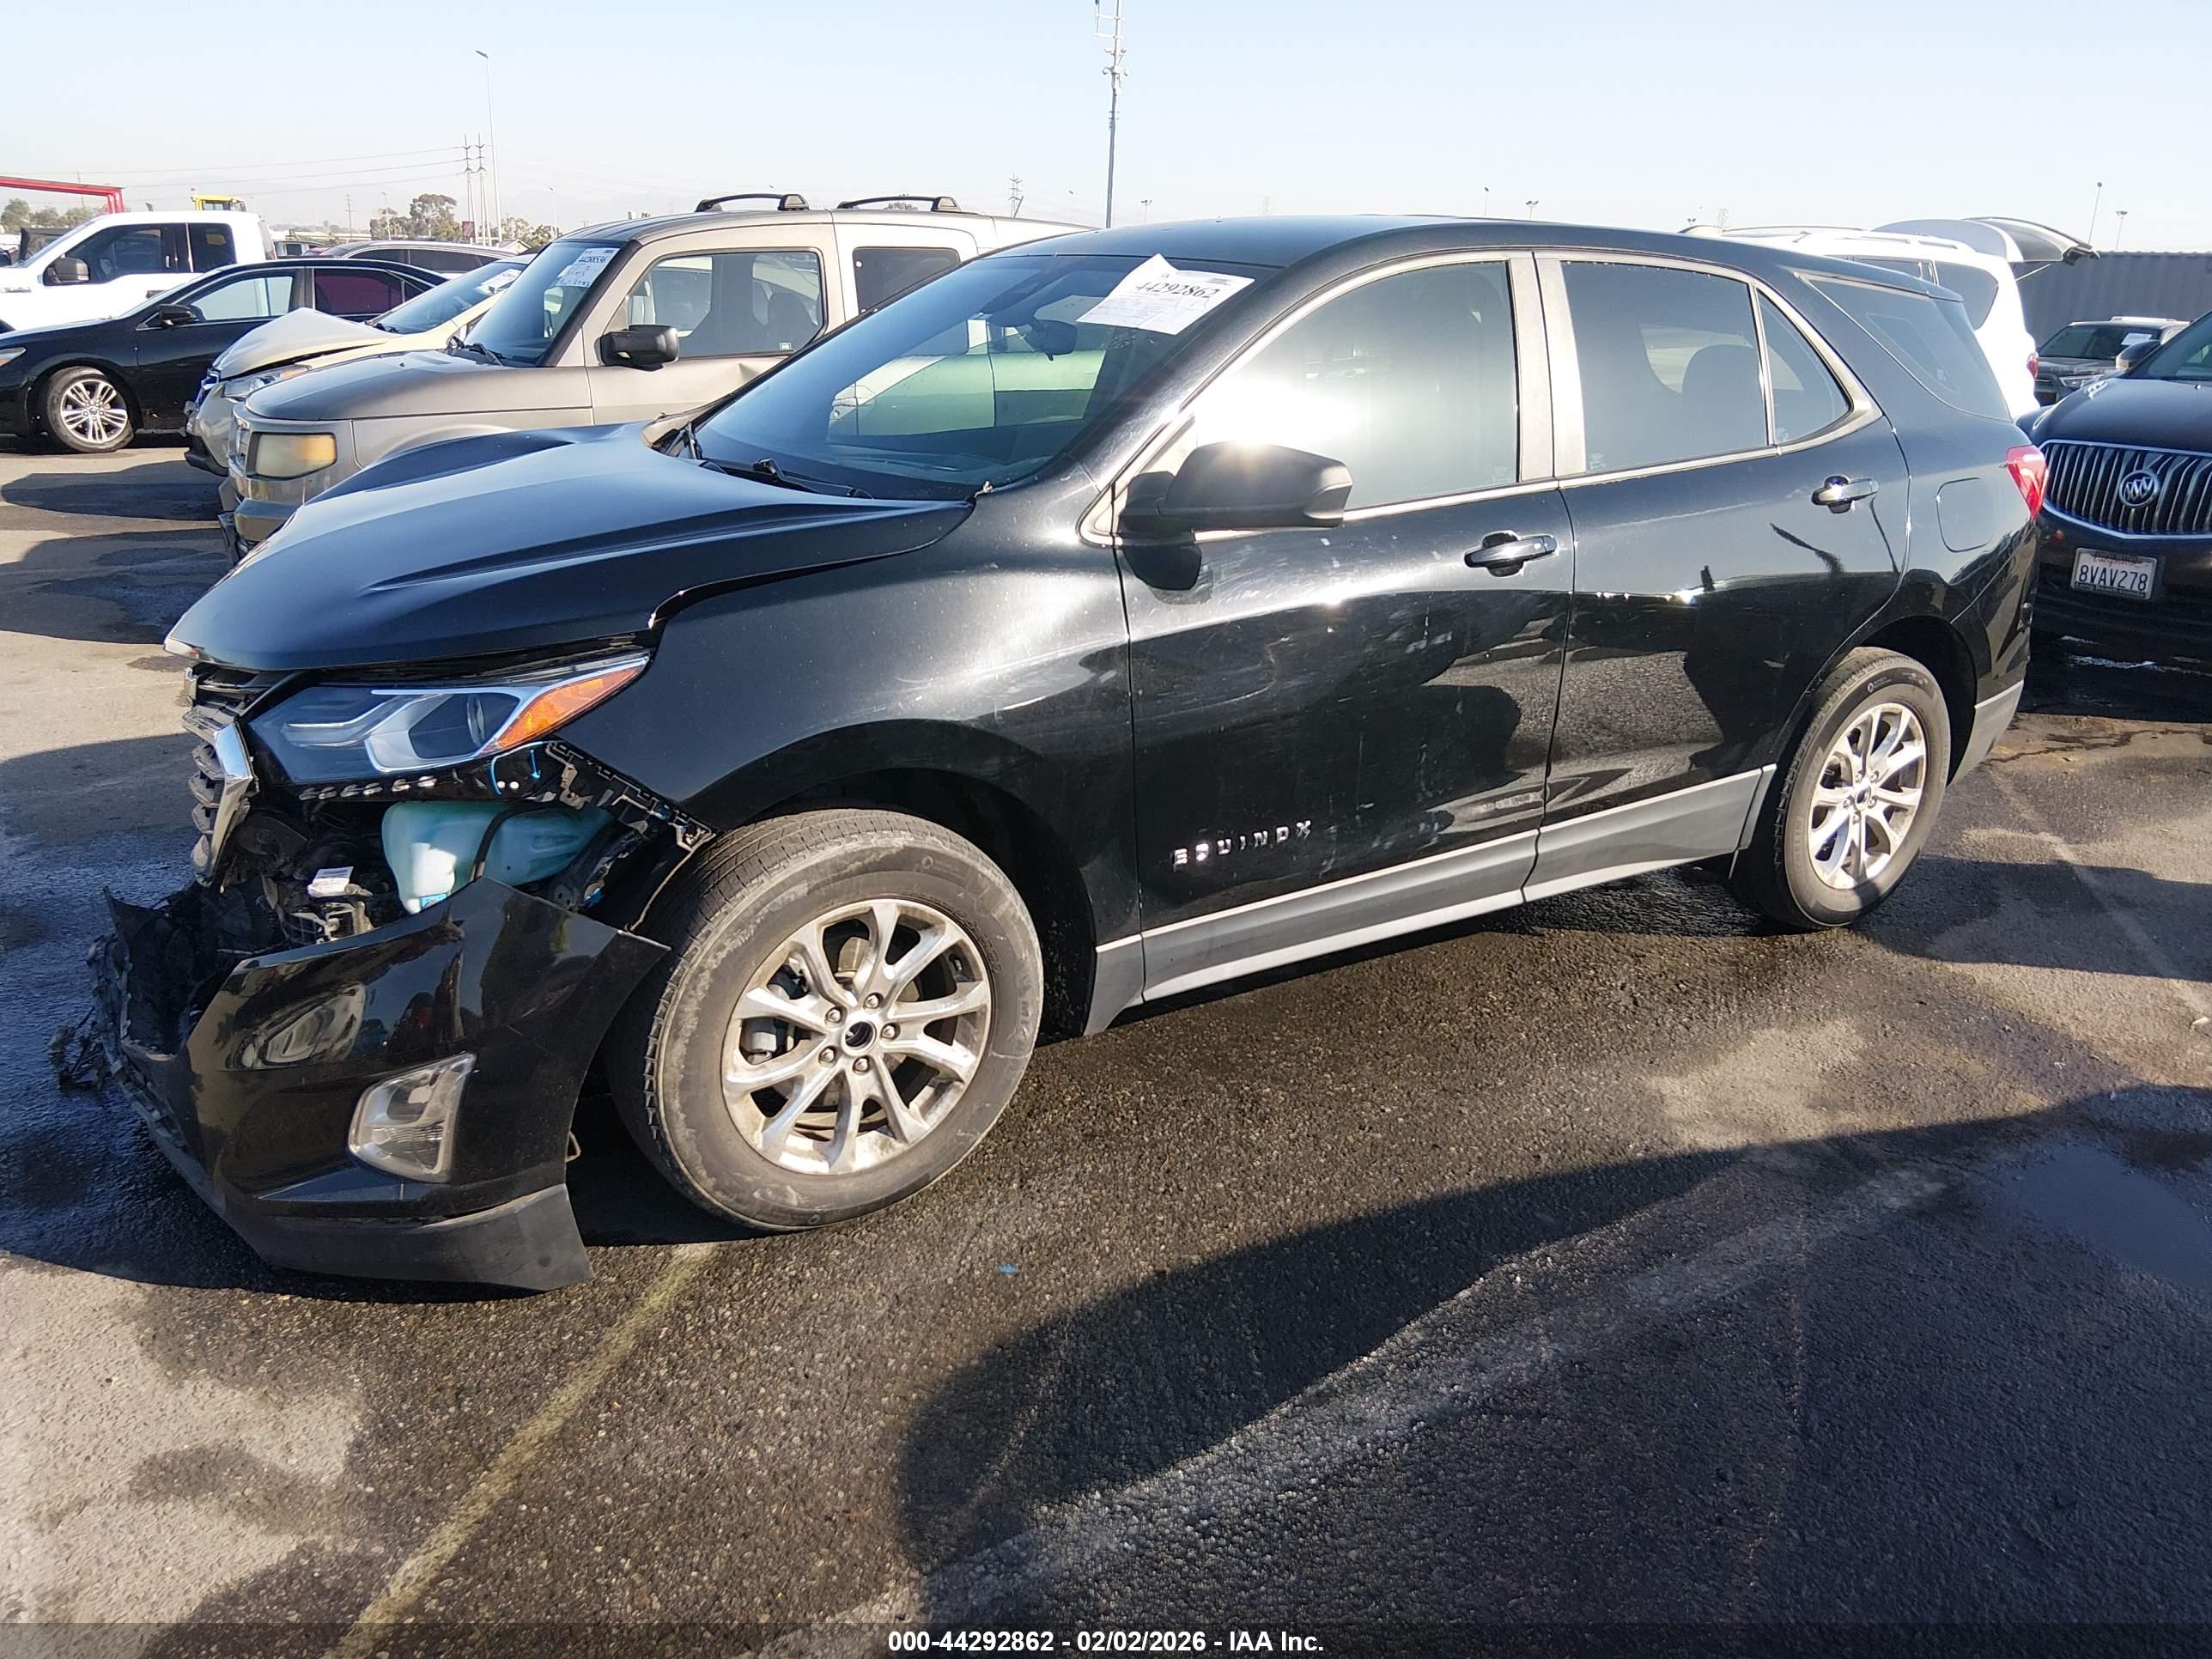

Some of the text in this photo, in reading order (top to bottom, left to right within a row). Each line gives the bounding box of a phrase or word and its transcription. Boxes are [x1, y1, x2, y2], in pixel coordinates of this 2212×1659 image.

[1136, 282, 1221, 299] 44292862
[2078, 564, 2148, 592] 8VAV278
[1173, 819, 1312, 871] EQUINOX
